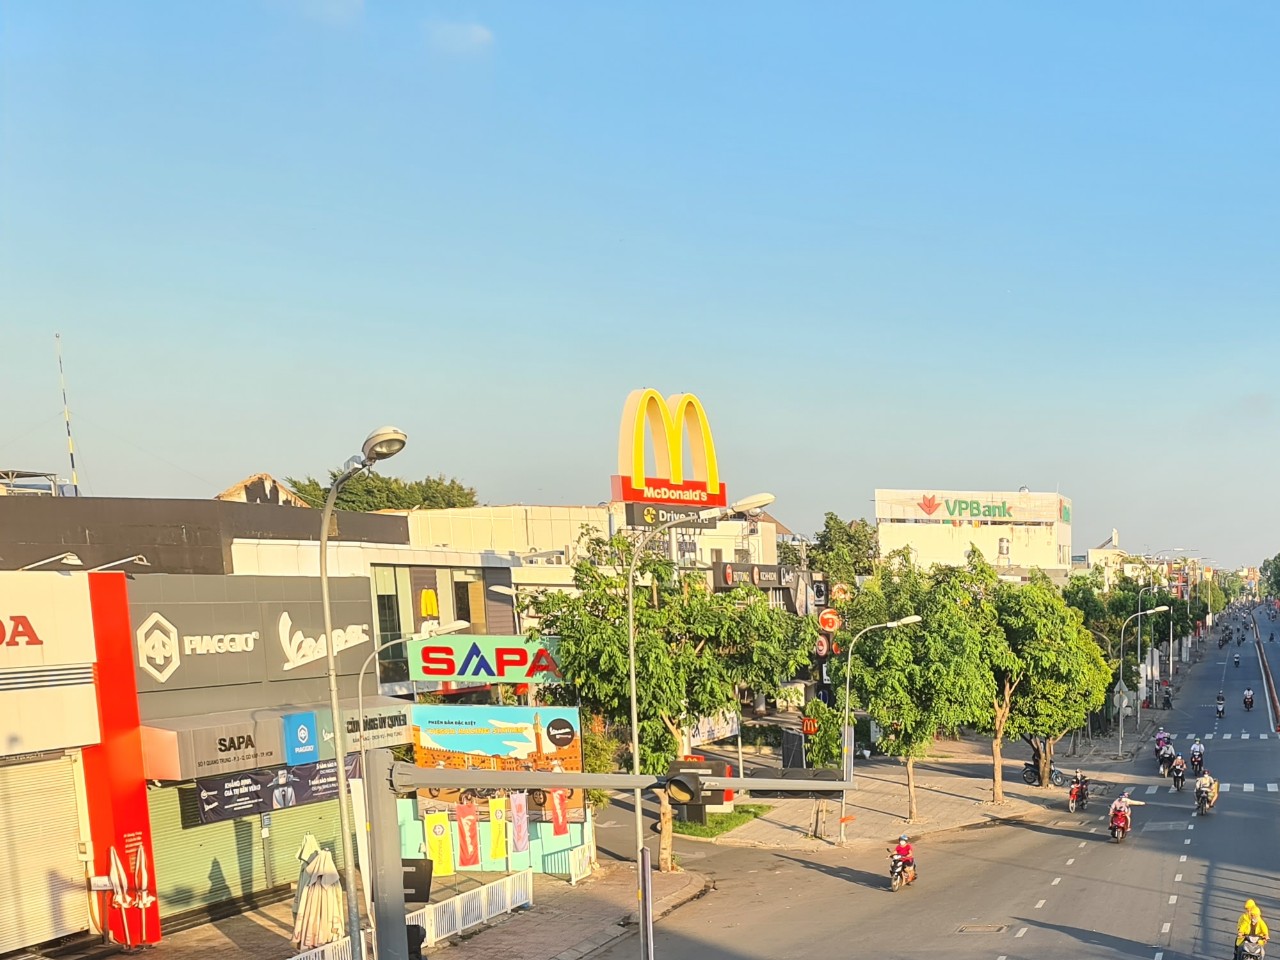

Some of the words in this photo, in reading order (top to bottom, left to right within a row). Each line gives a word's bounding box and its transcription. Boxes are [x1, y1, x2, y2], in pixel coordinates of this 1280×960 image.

[644, 487, 708, 501] McDonald's
[659, 510, 686, 521] Drive
[945, 499, 1013, 517] VPBank
[183, 632, 259, 655] PIAGGIO
[217, 735, 256, 753] SAPA
